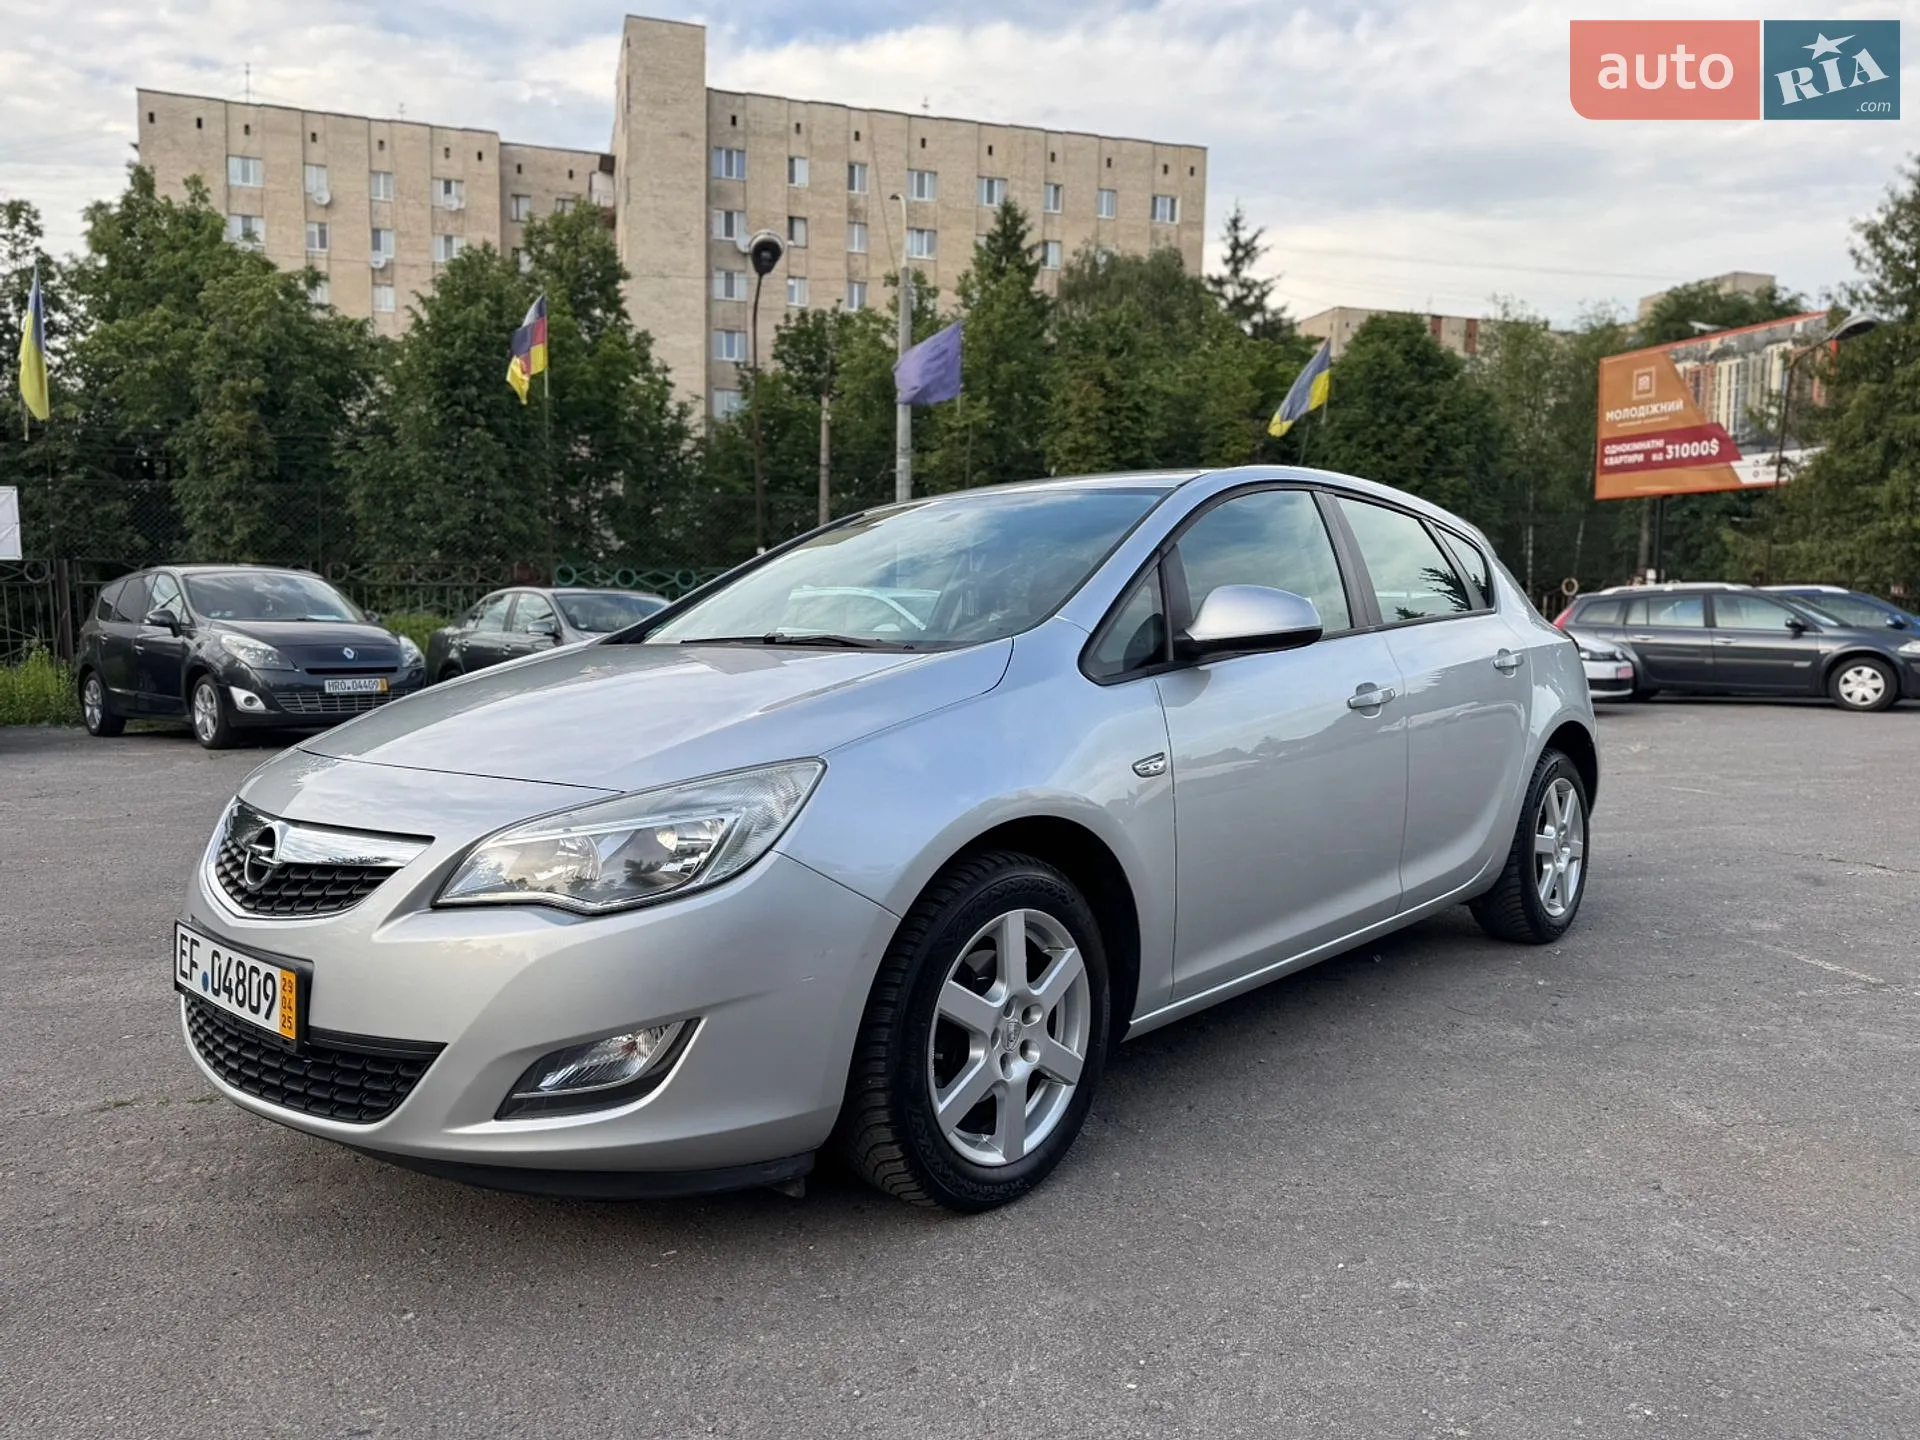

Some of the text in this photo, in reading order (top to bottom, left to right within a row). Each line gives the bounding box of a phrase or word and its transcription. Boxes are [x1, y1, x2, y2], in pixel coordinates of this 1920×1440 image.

[1605, 399, 1683, 422] МОЛОДІЖНИЙ
[1665, 438, 1720, 459] 31000$
[281, 997, 293, 1012] 04
[281, 1013, 293, 1030] 25
